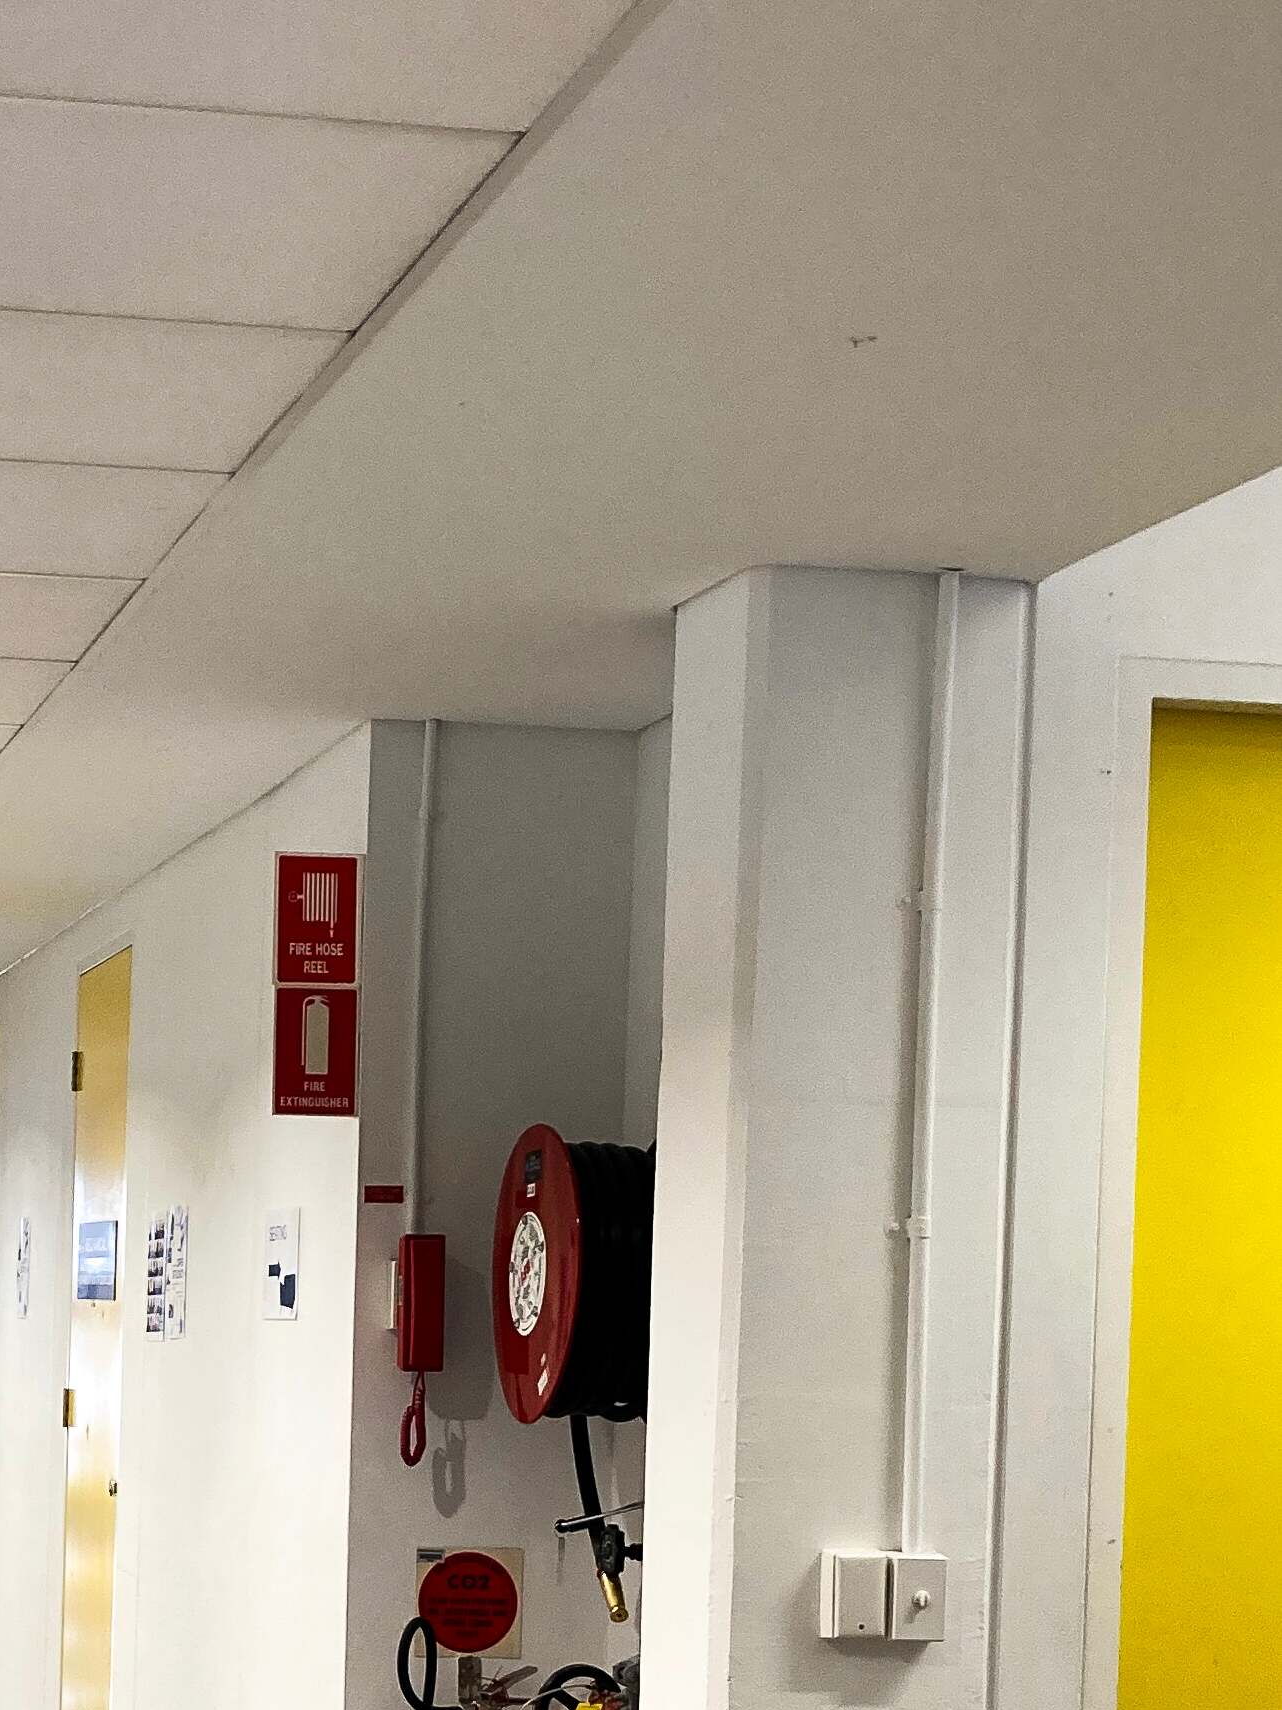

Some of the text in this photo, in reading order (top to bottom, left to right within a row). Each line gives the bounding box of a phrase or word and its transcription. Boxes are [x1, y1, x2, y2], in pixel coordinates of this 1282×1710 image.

[289, 942, 344, 956] FIRE HOSE
[303, 960, 329, 974] REEL
[303, 1081, 326, 1092] FIRE
[280, 1096, 349, 1108] EXTINGUISHER
[446, 1573, 490, 1590] CO2
